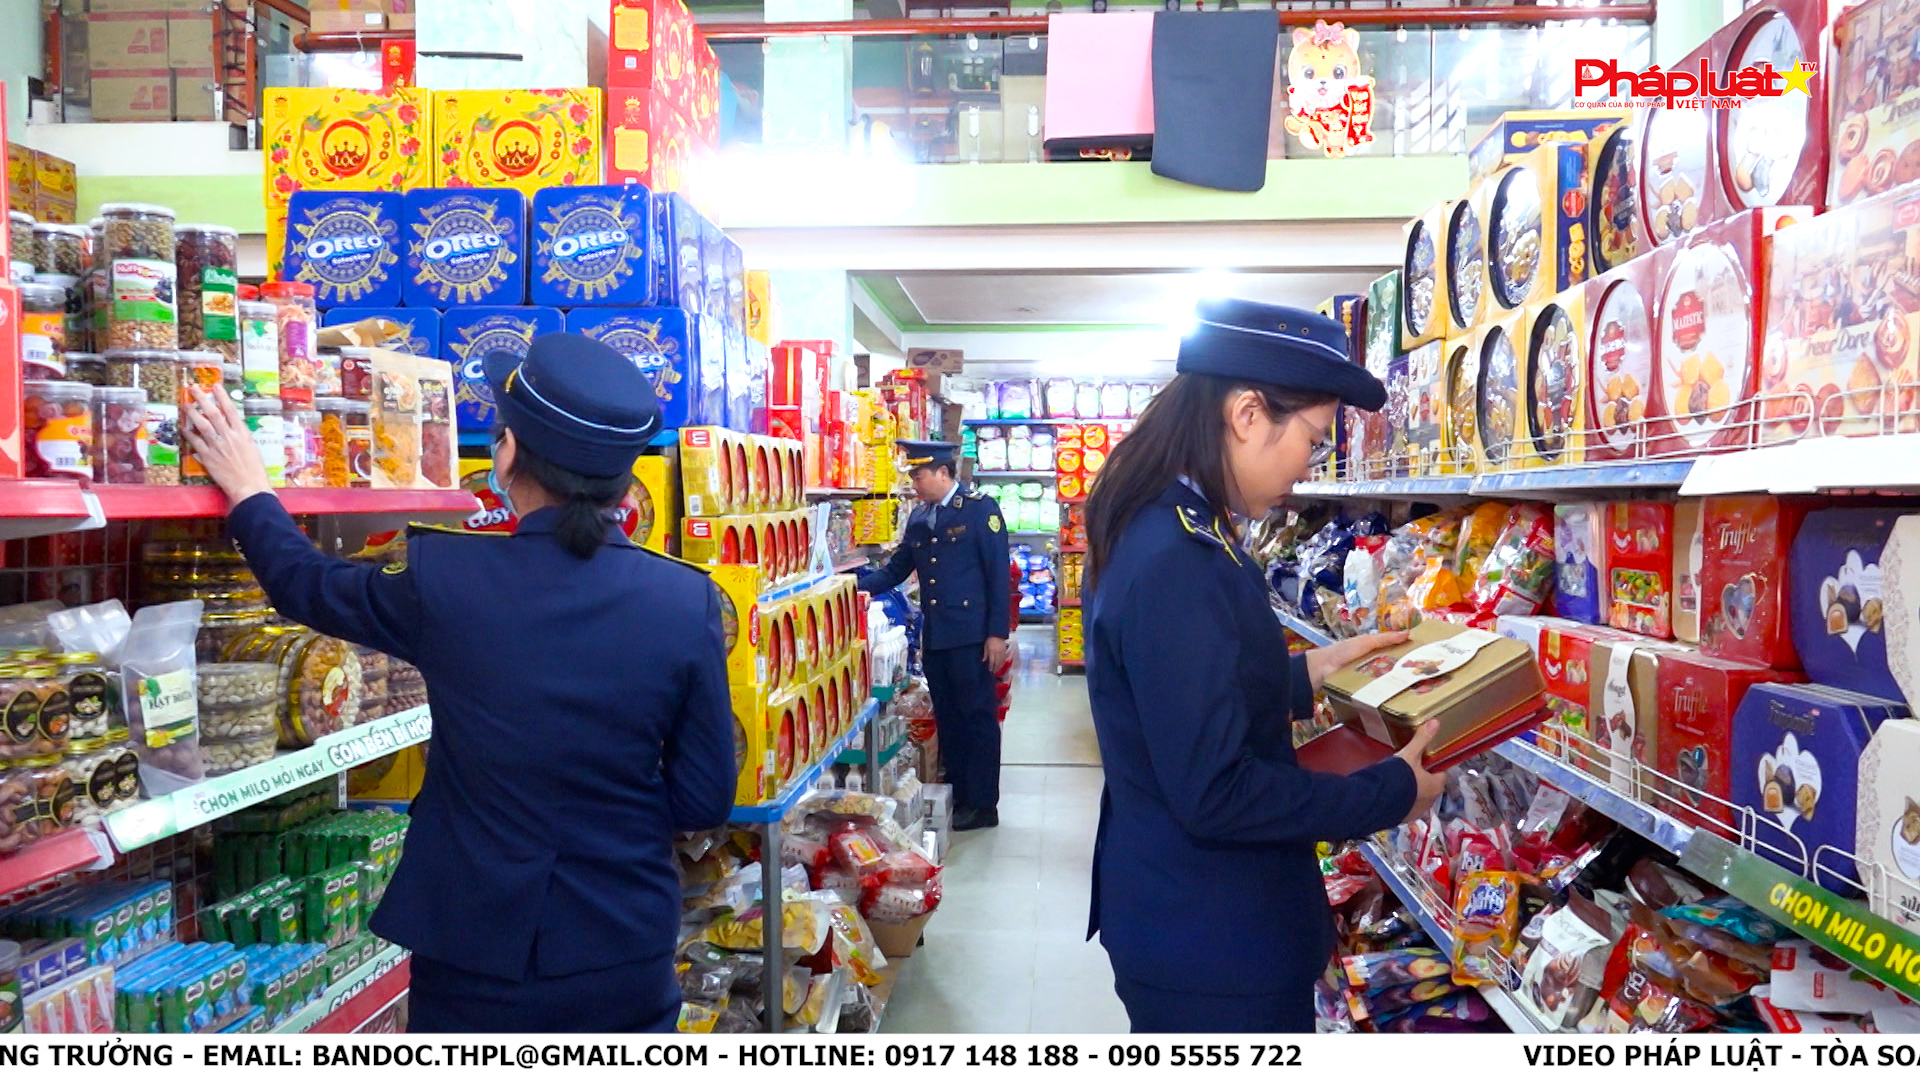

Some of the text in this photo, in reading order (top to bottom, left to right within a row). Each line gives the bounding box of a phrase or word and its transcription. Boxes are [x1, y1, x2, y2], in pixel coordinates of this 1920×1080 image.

[307, 235, 383, 259] OREO
[425, 233, 500, 260] OREO
[553, 230, 627, 257] OREO
[239, 779, 271, 799] MILO
[1770, 883, 1829, 928] CHỌN
[1825, 911, 1887, 960] MILO
